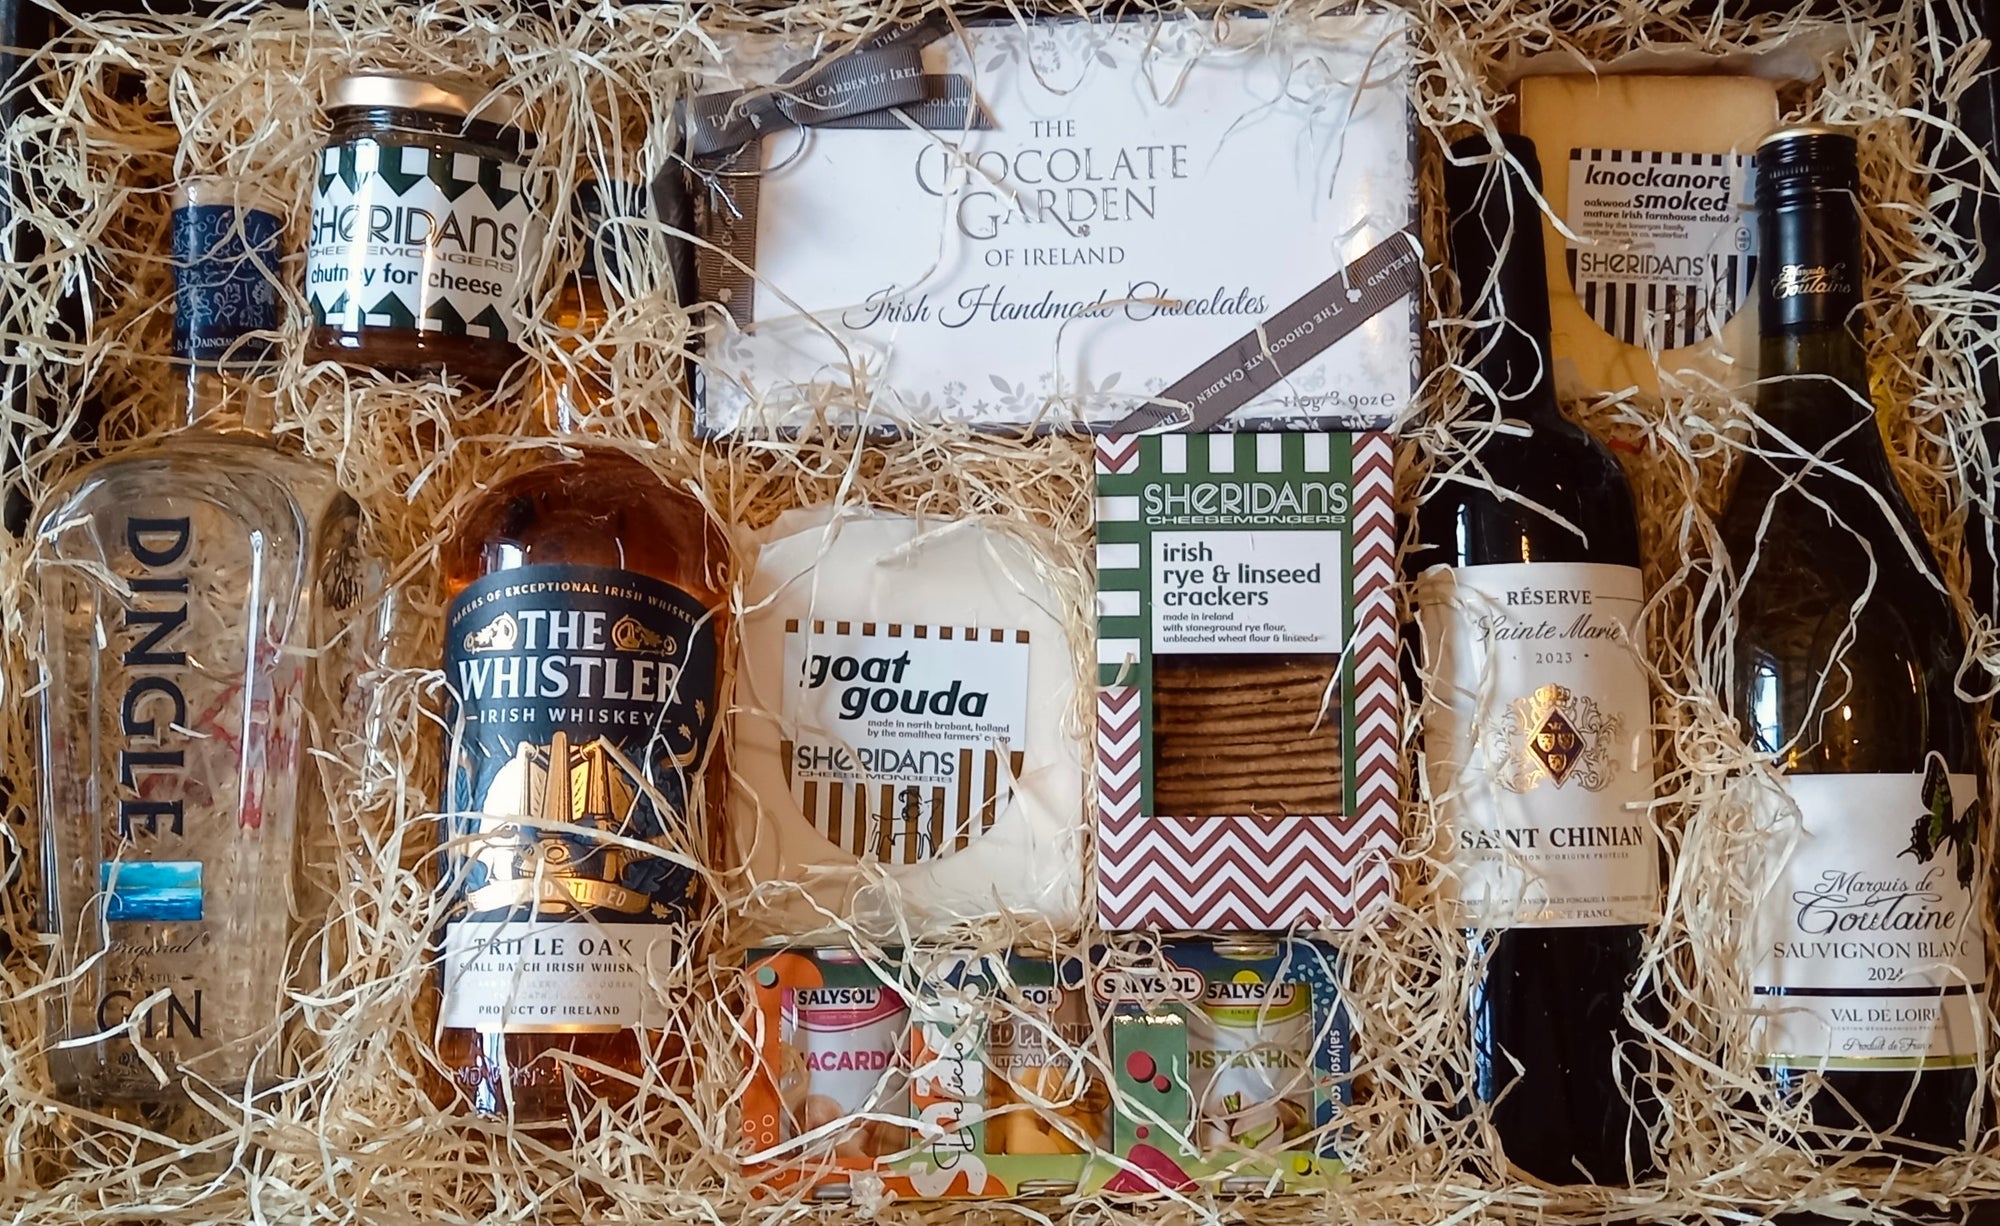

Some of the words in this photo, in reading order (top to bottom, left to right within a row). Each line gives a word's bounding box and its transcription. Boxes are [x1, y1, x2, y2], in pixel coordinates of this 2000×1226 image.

[1030, 120, 1077, 138] THE
[1584, 164, 1731, 190] knockanore
[1584, 199, 1631, 208] oakwood
[1633, 190, 1730, 211] smoked
[956, 185, 1157, 240] GARDEN
[1583, 210, 1620, 219] mature
[1621, 210, 1643, 219] irish
[1645, 211, 1697, 222] farmhouse
[1699, 213, 1740, 223] cheddr
[984, 248, 1015, 267] OF
[1023, 246, 1126, 267] IRELAND
[311, 261, 376, 287] chutny
[384, 262, 418, 285] for
[428, 267, 503, 297] cheese
[1367, 250, 1417, 287] IRELAND
[842, 284, 932, 330] Irish
[938, 283, 1115, 329] Handmade
[1124, 280, 1270, 322] Chocolates
[1313, 302, 1343, 324] THE
[1247, 321, 1315, 373] CHOCOATE
[1197, 368, 1246, 405] GARDEN
[1146, 515, 1346, 525] CHEESEMONGERS
[1163, 541, 1213, 562] irish
[1163, 569, 1204, 589] rye
[1212, 565, 1230, 584] &
[1238, 563, 1321, 584] linseed
[452, 596, 483, 628] MAKERS
[486, 589, 501, 603] OF
[504, 581, 600, 598] EXCEPTIONAL
[604, 585, 643, 601] IRISH
[648, 595, 697, 627] WHISKEY
[1163, 586, 1269, 606] crackers
[1507, 587, 1592, 606] RÉSERVE
[1163, 612, 1188, 621] made
[1191, 612, 1199, 621] in
[1202, 612, 1234, 621] ireland
[517, 610, 606, 651] THE
[1163, 623, 1183, 632] with
[1185, 623, 1242, 634] stoneground
[1245, 624, 1260, 635] rye
[1263, 623, 1286, 633] flour,
[1163, 634, 1215, 643] unbleached
[1217, 634, 1247, 643] wheat
[1249, 634, 1270, 643] flour
[1273, 634, 1280, 642] &
[1475, 613, 1556, 643] Sainte
[1559, 613, 1621, 641] Marie
[1536, 652, 1573, 664] 2023
[118, 517, 190, 838] DINGLE
[458, 655, 682, 705] WHISTLER
[799, 650, 911, 689] goat
[838, 680, 989, 721] gouda
[480, 708, 536, 724] IRISH
[548, 708, 655, 727] WHISKEY
[868, 719, 894, 728] made
[896, 719, 905, 728] in
[907, 720, 932, 729] north
[934, 721, 974, 732] brabant,
[975, 722, 1010, 733] holland
[867, 728, 879, 738] by
[881, 729, 897, 738] the
[899, 729, 942, 740] amalthea
[944, 731, 982, 741] farmers'
[984, 735, 1011, 744] c-op
[1549, 826, 1643, 849] CHINIAN
[1814, 870, 1909, 906] Marquis
[1915, 866, 1945, 892] de
[578, 938, 632, 957] OAK
[1773, 942, 1910, 959] SAUVIGNON
[1918, 942, 1969, 958] BLANC
[498, 962, 540, 973] BACH
[546, 962, 584, 973] IRISH
[591, 962, 646, 974] WHISK
[1103, 977, 1195, 994] SLYSOL
[798, 988, 876, 1005] SALYSOL
[97, 989, 203, 1039] GIN
[478, 1005, 535, 1015] PROUCT
[540, 1005, 557, 1015] OF
[563, 1005, 620, 1015] IRELAND
[1831, 1008, 1862, 1021] VAL
[1868, 1008, 1891, 1022] DE
[1843, 1036, 1886, 1051] Produit
[1888, 1040, 1897, 1051] de
[1900, 1037, 1932, 1052] Frane
[1327, 1029, 1345, 1114] salysolcom
